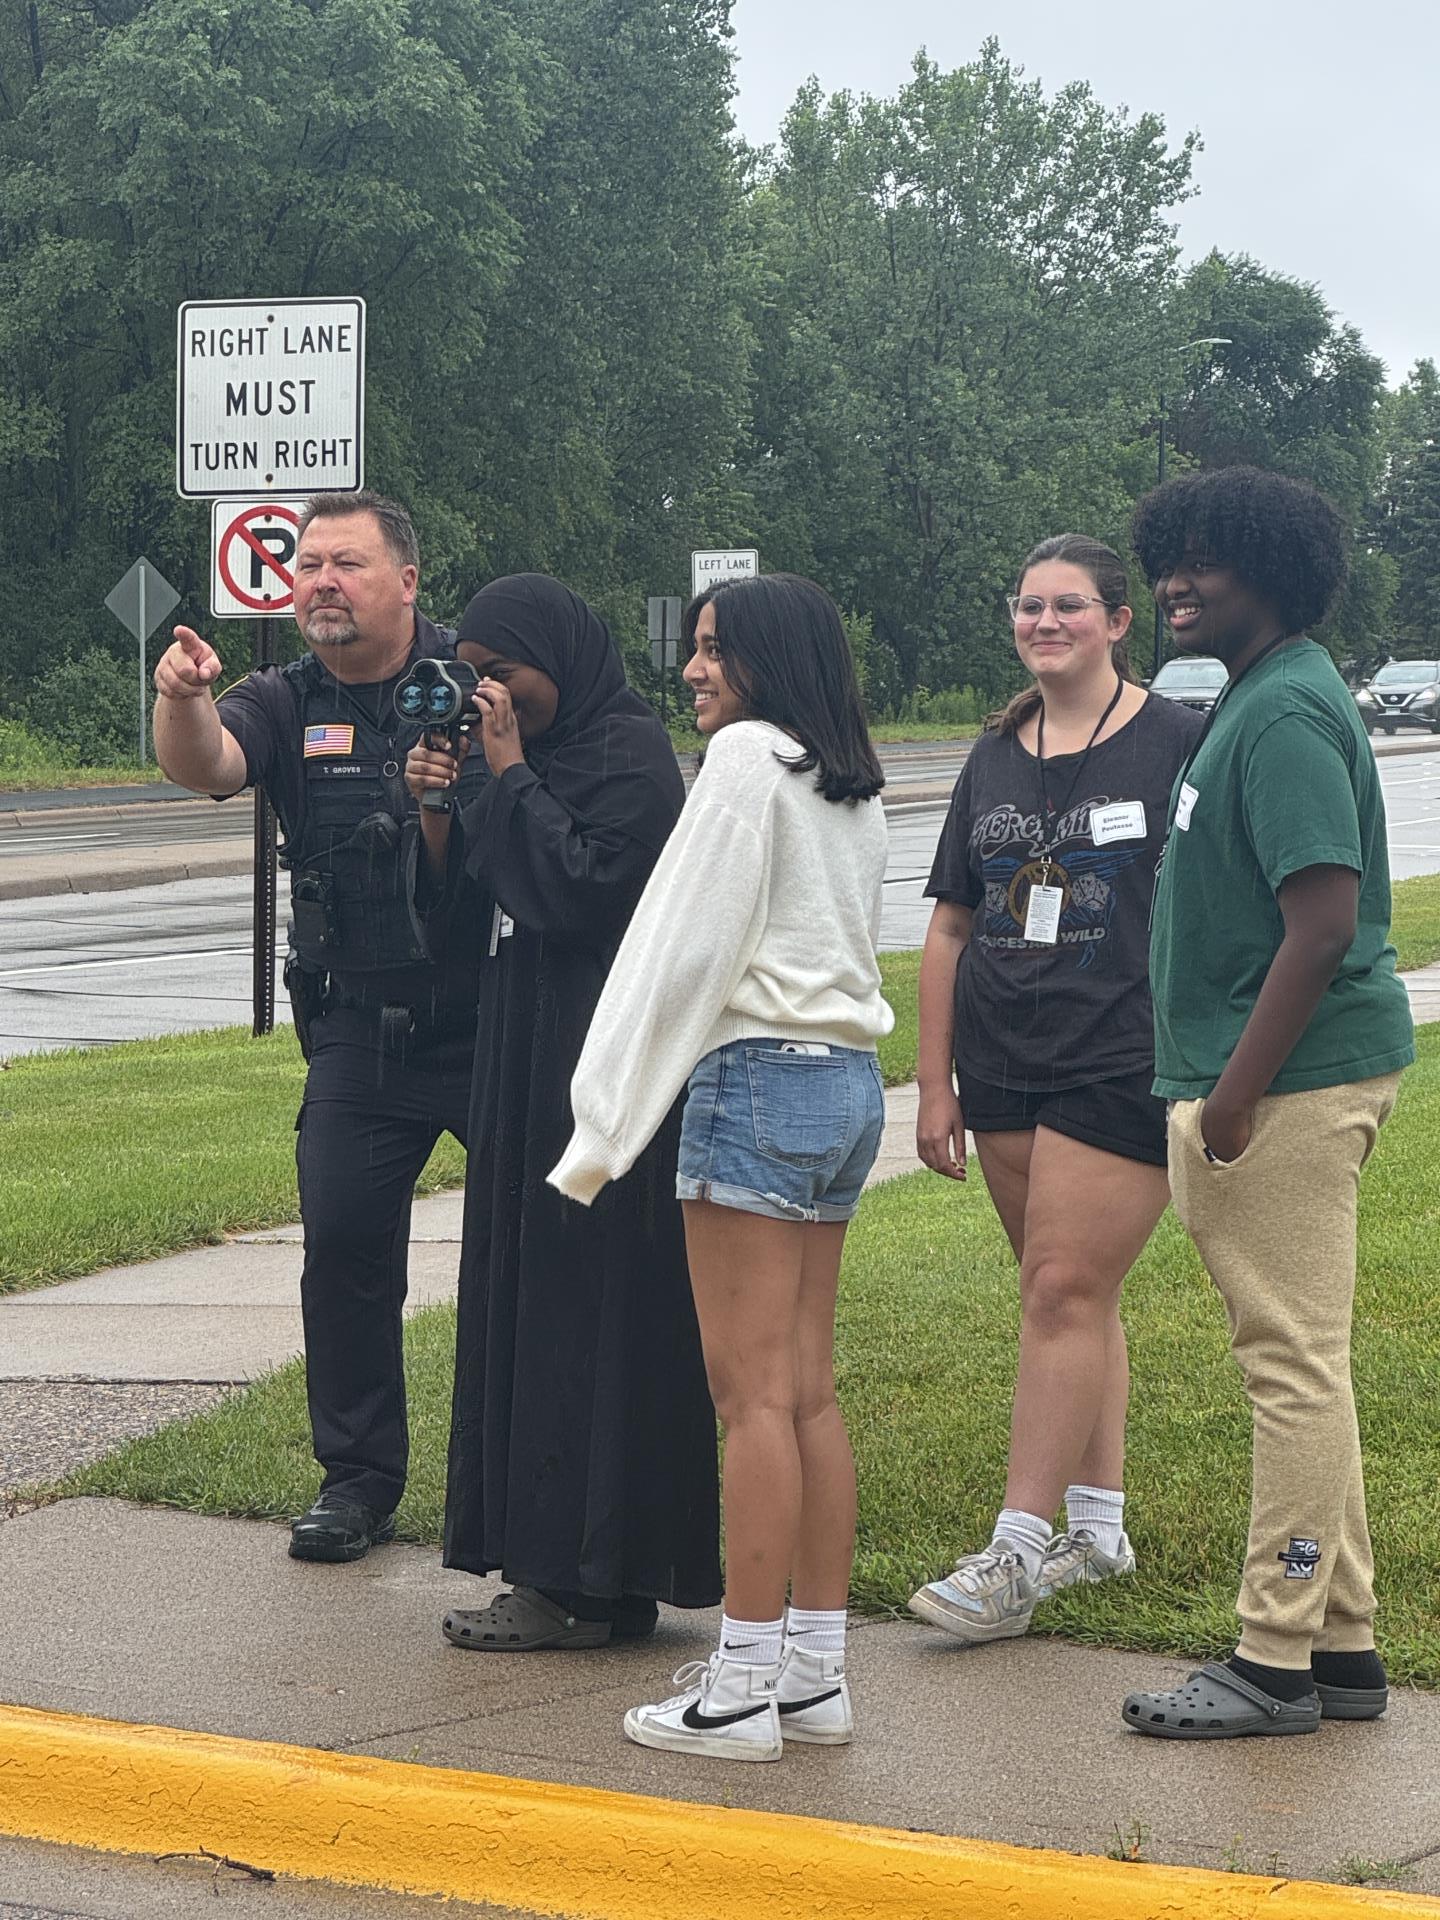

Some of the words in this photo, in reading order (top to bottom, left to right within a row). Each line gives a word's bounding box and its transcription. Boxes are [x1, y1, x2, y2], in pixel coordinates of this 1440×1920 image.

[191, 327, 269, 357] RIGHT
[284, 324, 352, 354] LANE
[225, 379, 316, 416] MUST
[190, 441, 258, 471] TURN
[275, 438, 352, 468] RIGHT
[250, 527, 296, 588] P
[699, 559, 721, 570] LEFT
[727, 559, 751, 569] LANE
[332, 766, 361, 774] GROVES
[1060, 927, 1106, 943] WILD
